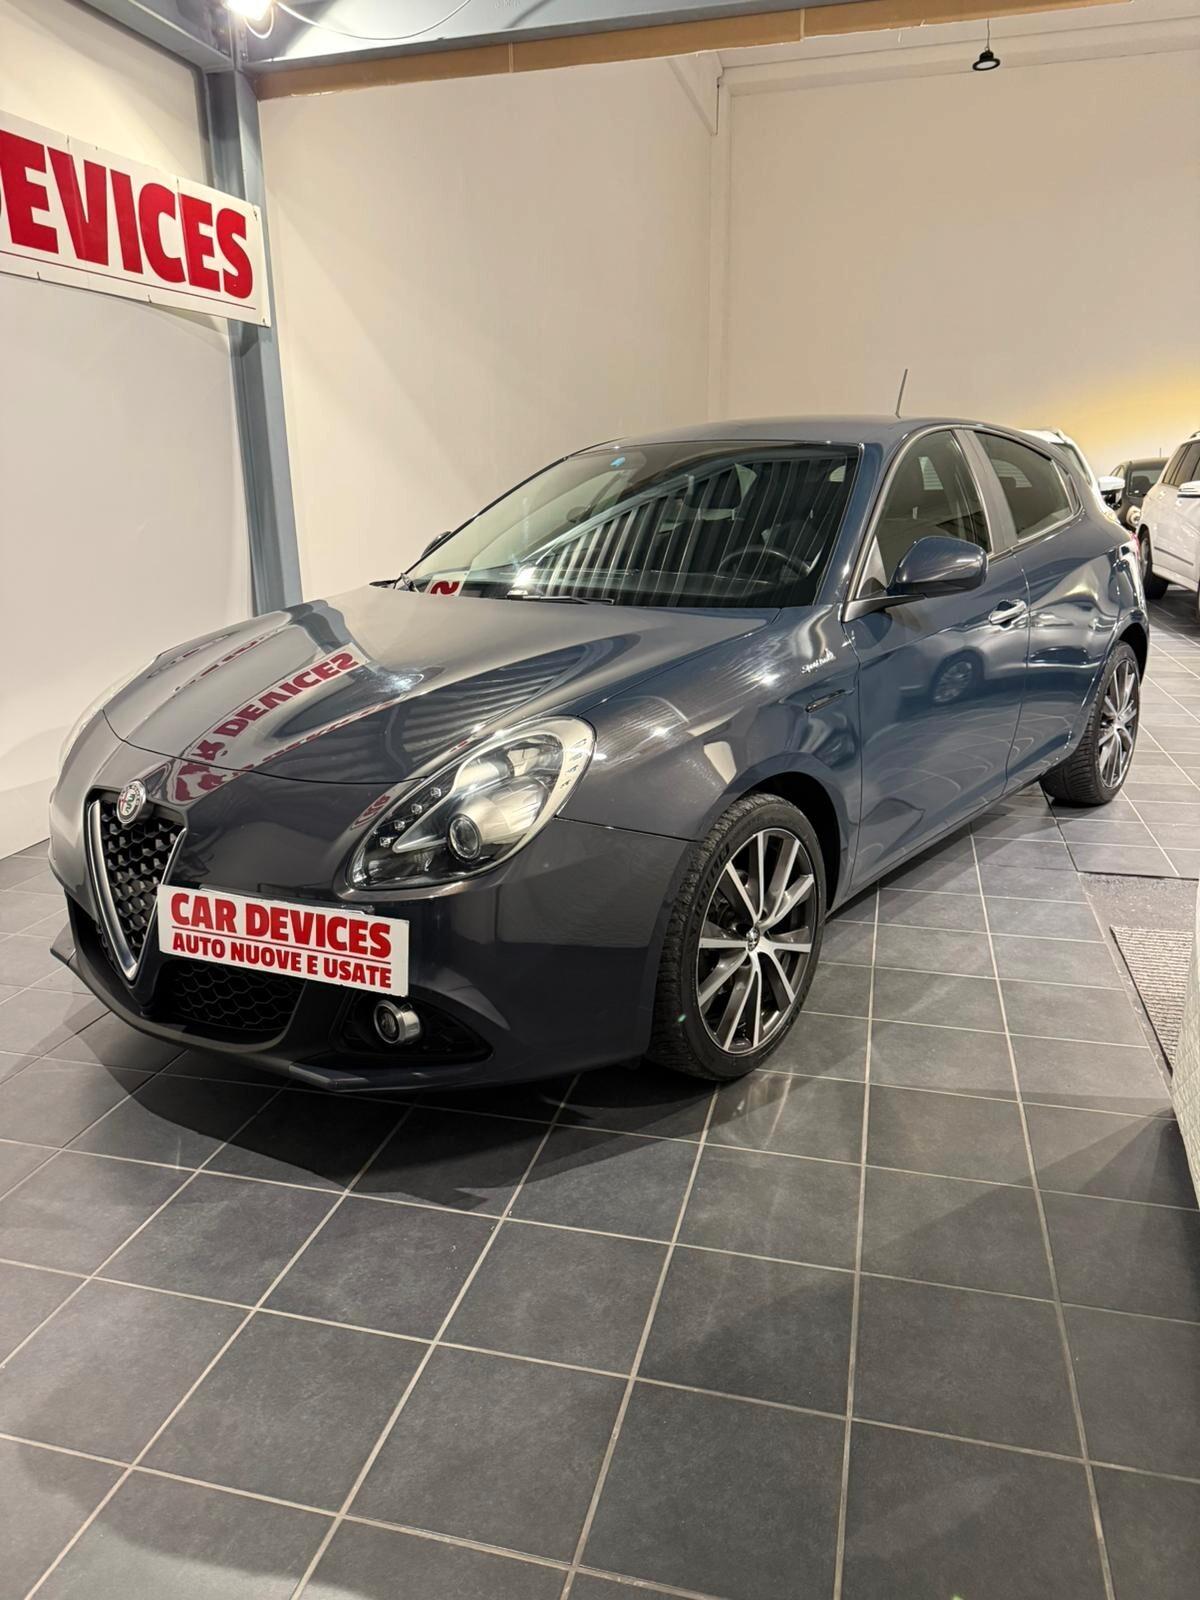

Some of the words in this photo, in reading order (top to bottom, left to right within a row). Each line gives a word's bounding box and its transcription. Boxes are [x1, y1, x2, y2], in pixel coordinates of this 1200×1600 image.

[0, 128, 254, 299] EVICES
[170, 892, 237, 934] CAR
[245, 903, 392, 959] DEVICES
[172, 932, 226, 960] AUTO
[230, 941, 301, 972] NUOVE
[306, 955, 318, 975] E
[323, 957, 392, 989] USATE
